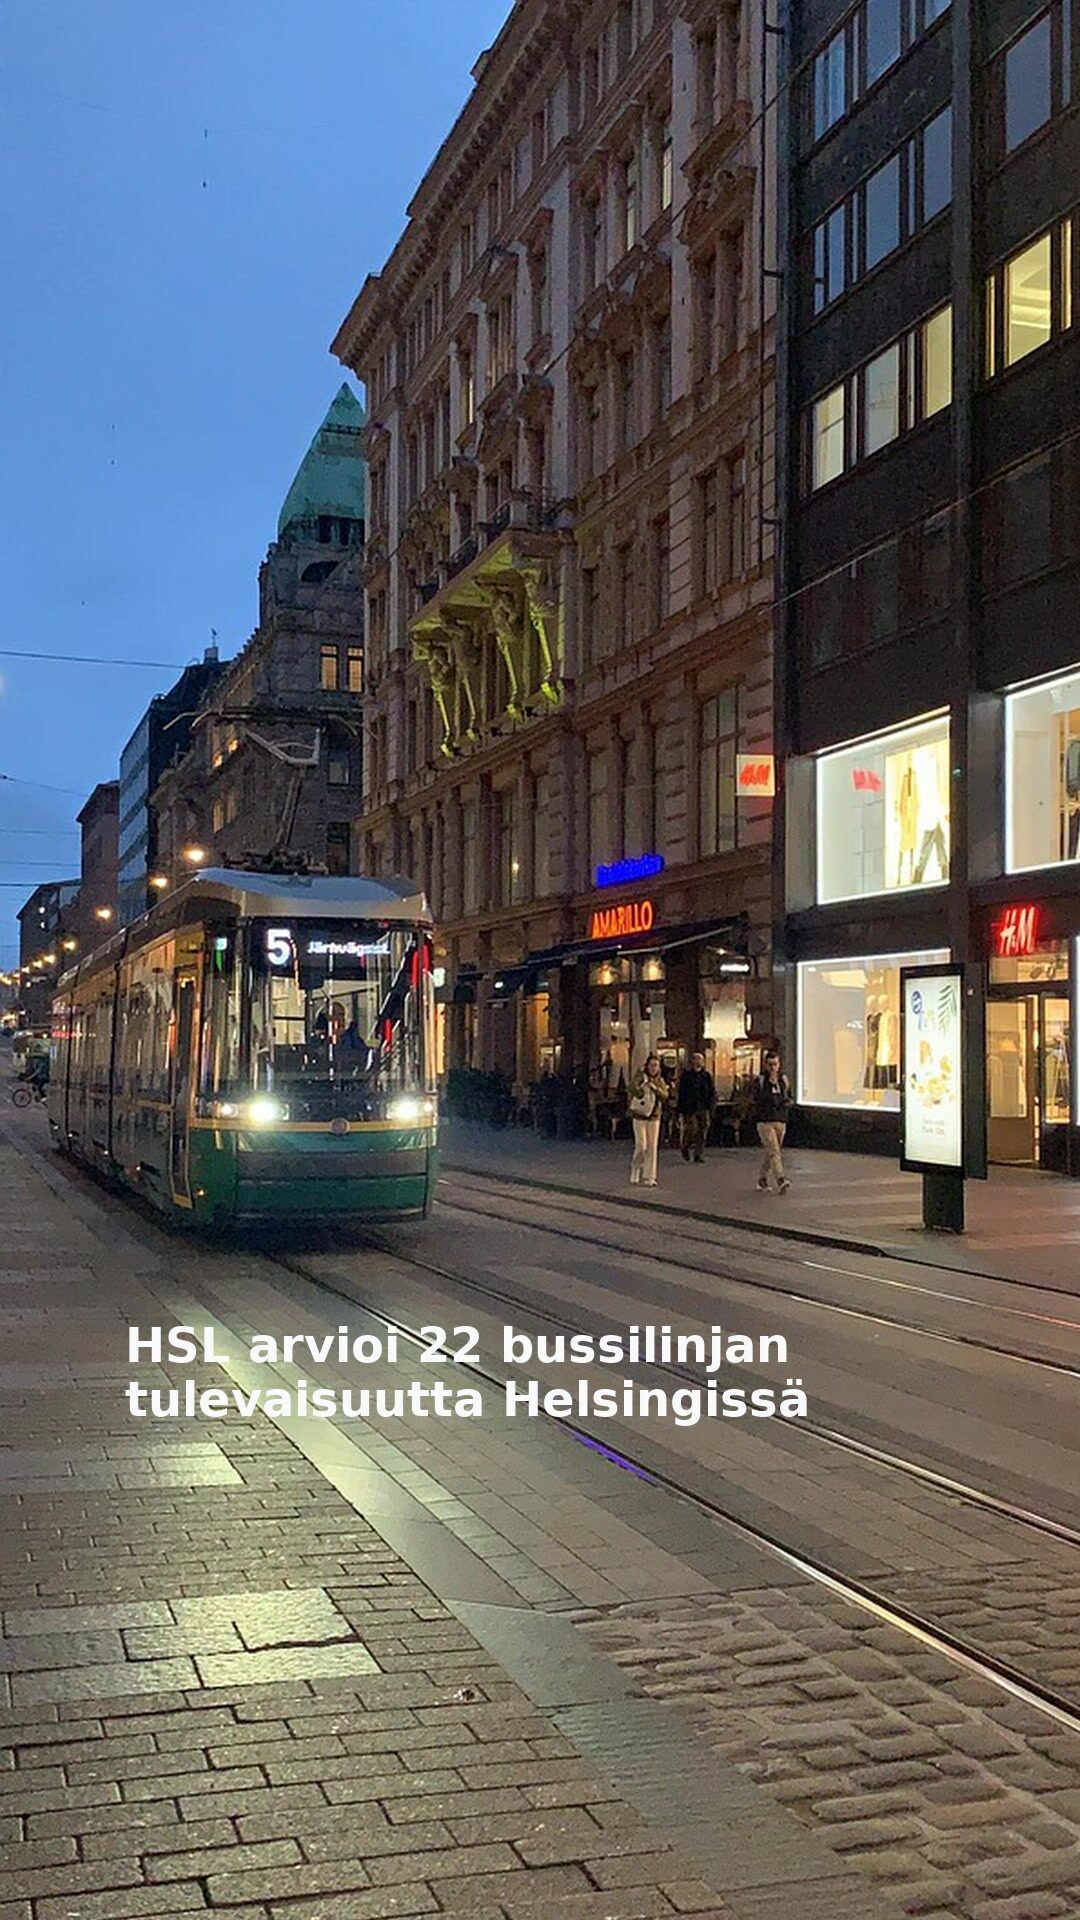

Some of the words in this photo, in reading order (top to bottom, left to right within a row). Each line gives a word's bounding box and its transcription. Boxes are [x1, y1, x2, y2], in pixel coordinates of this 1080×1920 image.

[592, 900, 653, 939] AMARILLO
[1000, 906, 1036, 956] H&M
[267, 928, 291, 966] 5
